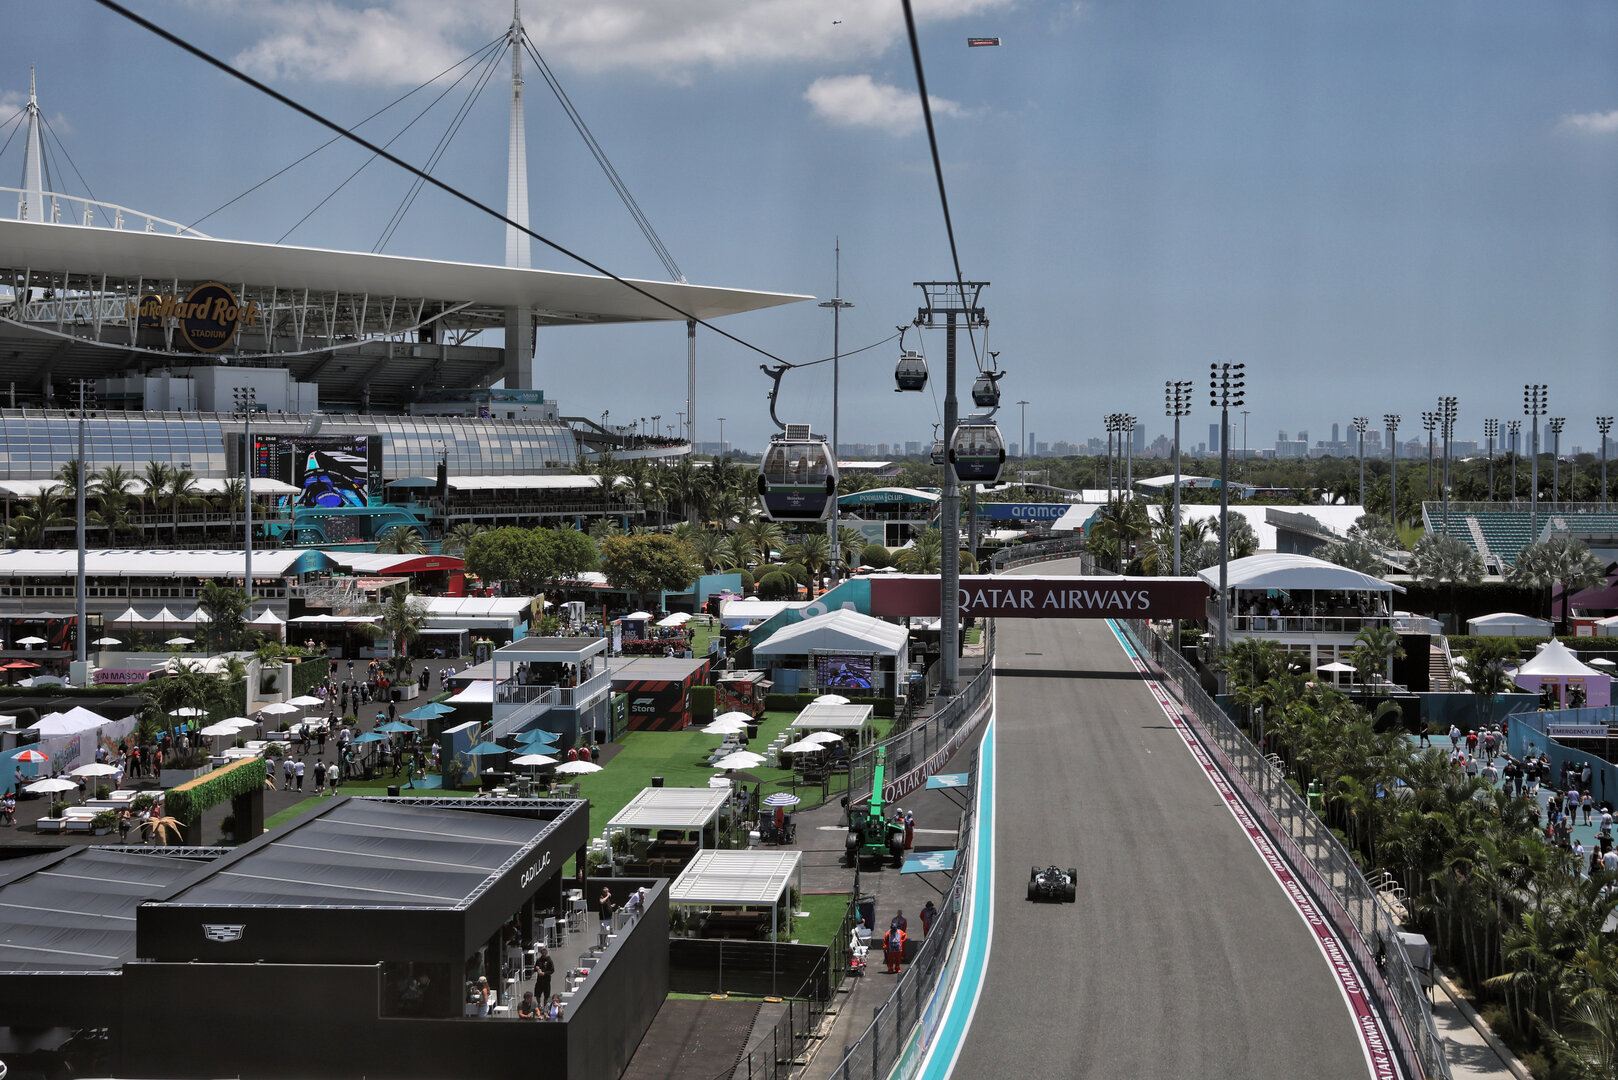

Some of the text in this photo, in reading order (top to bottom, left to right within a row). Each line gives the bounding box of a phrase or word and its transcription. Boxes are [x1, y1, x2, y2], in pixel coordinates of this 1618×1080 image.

[161, 294, 258, 328] Hard Rock
[190, 329, 226, 339] STADIUM
[860, 493, 903, 501] PODIUM CLUB
[1011, 506, 1067, 518] aramco
[958, 589, 1150, 612] QATAR AIRWAYS
[110, 672, 145, 680] MASON
[631, 705, 656, 713] Store
[884, 770, 920, 804] QATAR
[520, 850, 551, 889] CADILLAC
[1320, 936, 1361, 994] QATAR AIRWAYS
[1359, 1014, 1387, 1056] AIRWAYS
